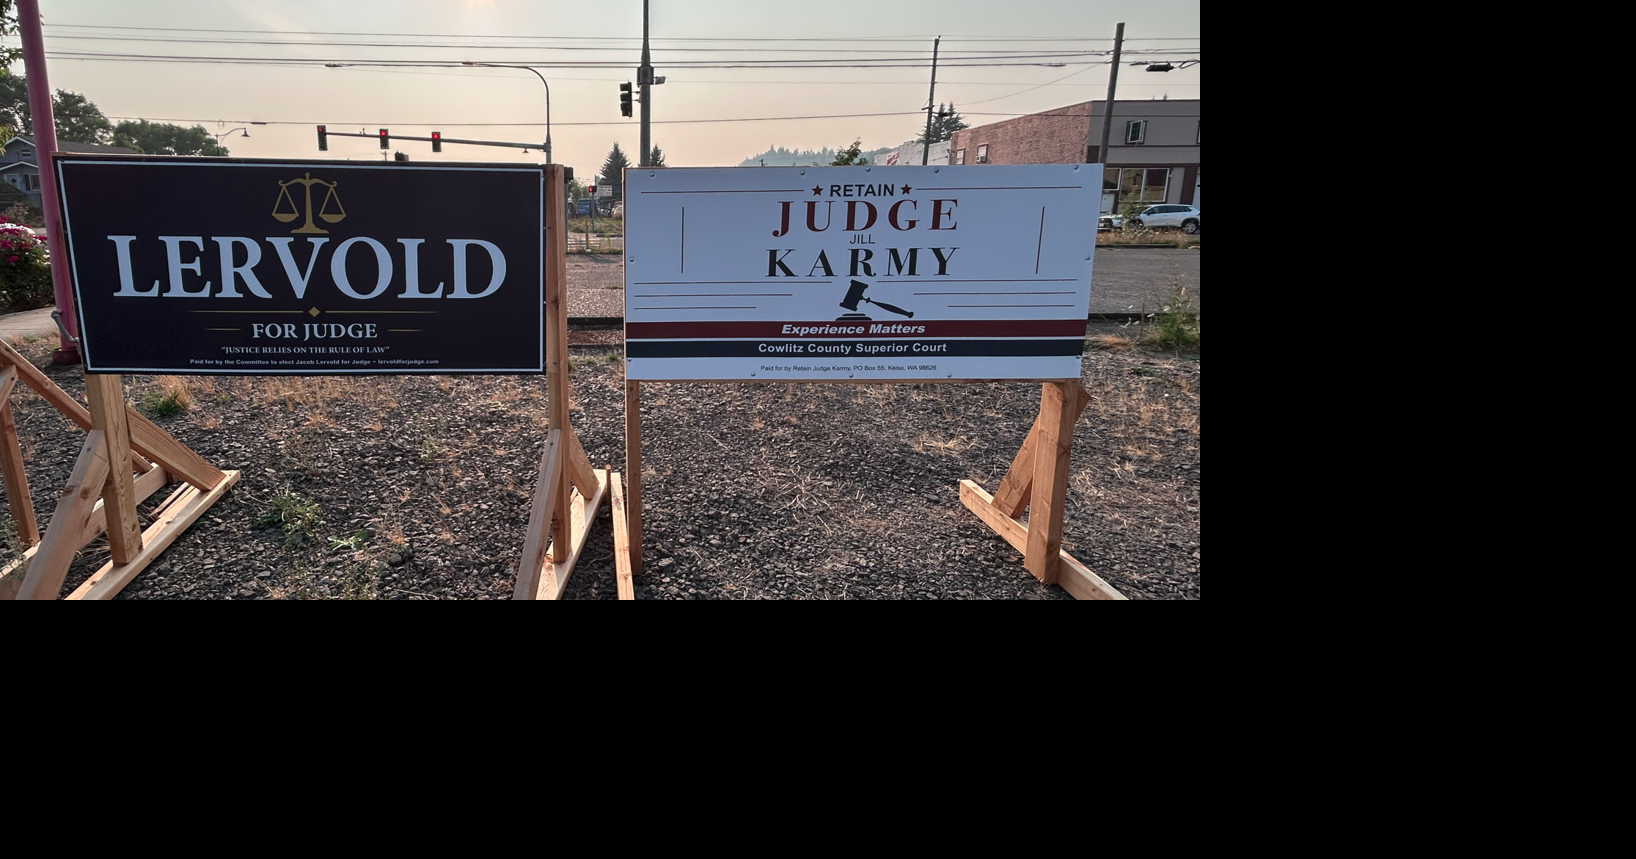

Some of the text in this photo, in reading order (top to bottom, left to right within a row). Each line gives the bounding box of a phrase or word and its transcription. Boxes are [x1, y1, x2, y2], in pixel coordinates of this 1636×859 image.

[829, 184, 895, 198] RETAIN
[772, 199, 959, 237] JUDGE
[849, 234, 876, 245] JILL
[106, 235, 508, 300] LERVOLD
[764, 247, 961, 277] KARMY
[251, 323, 378, 341] FOR JUDGE
[781, 323, 926, 336] Experience Matters
[262, 346, 292, 354] RELIES
[293, 346, 307, 354] ON
[308, 346, 328, 354] THE
[328, 346, 352, 354] RULE
[352, 346, 365, 354] OF
[758, 342, 947, 355] Cowlitz County Superior Court
[215, 358, 223, 366] by
[351, 358, 371, 366] Judge
